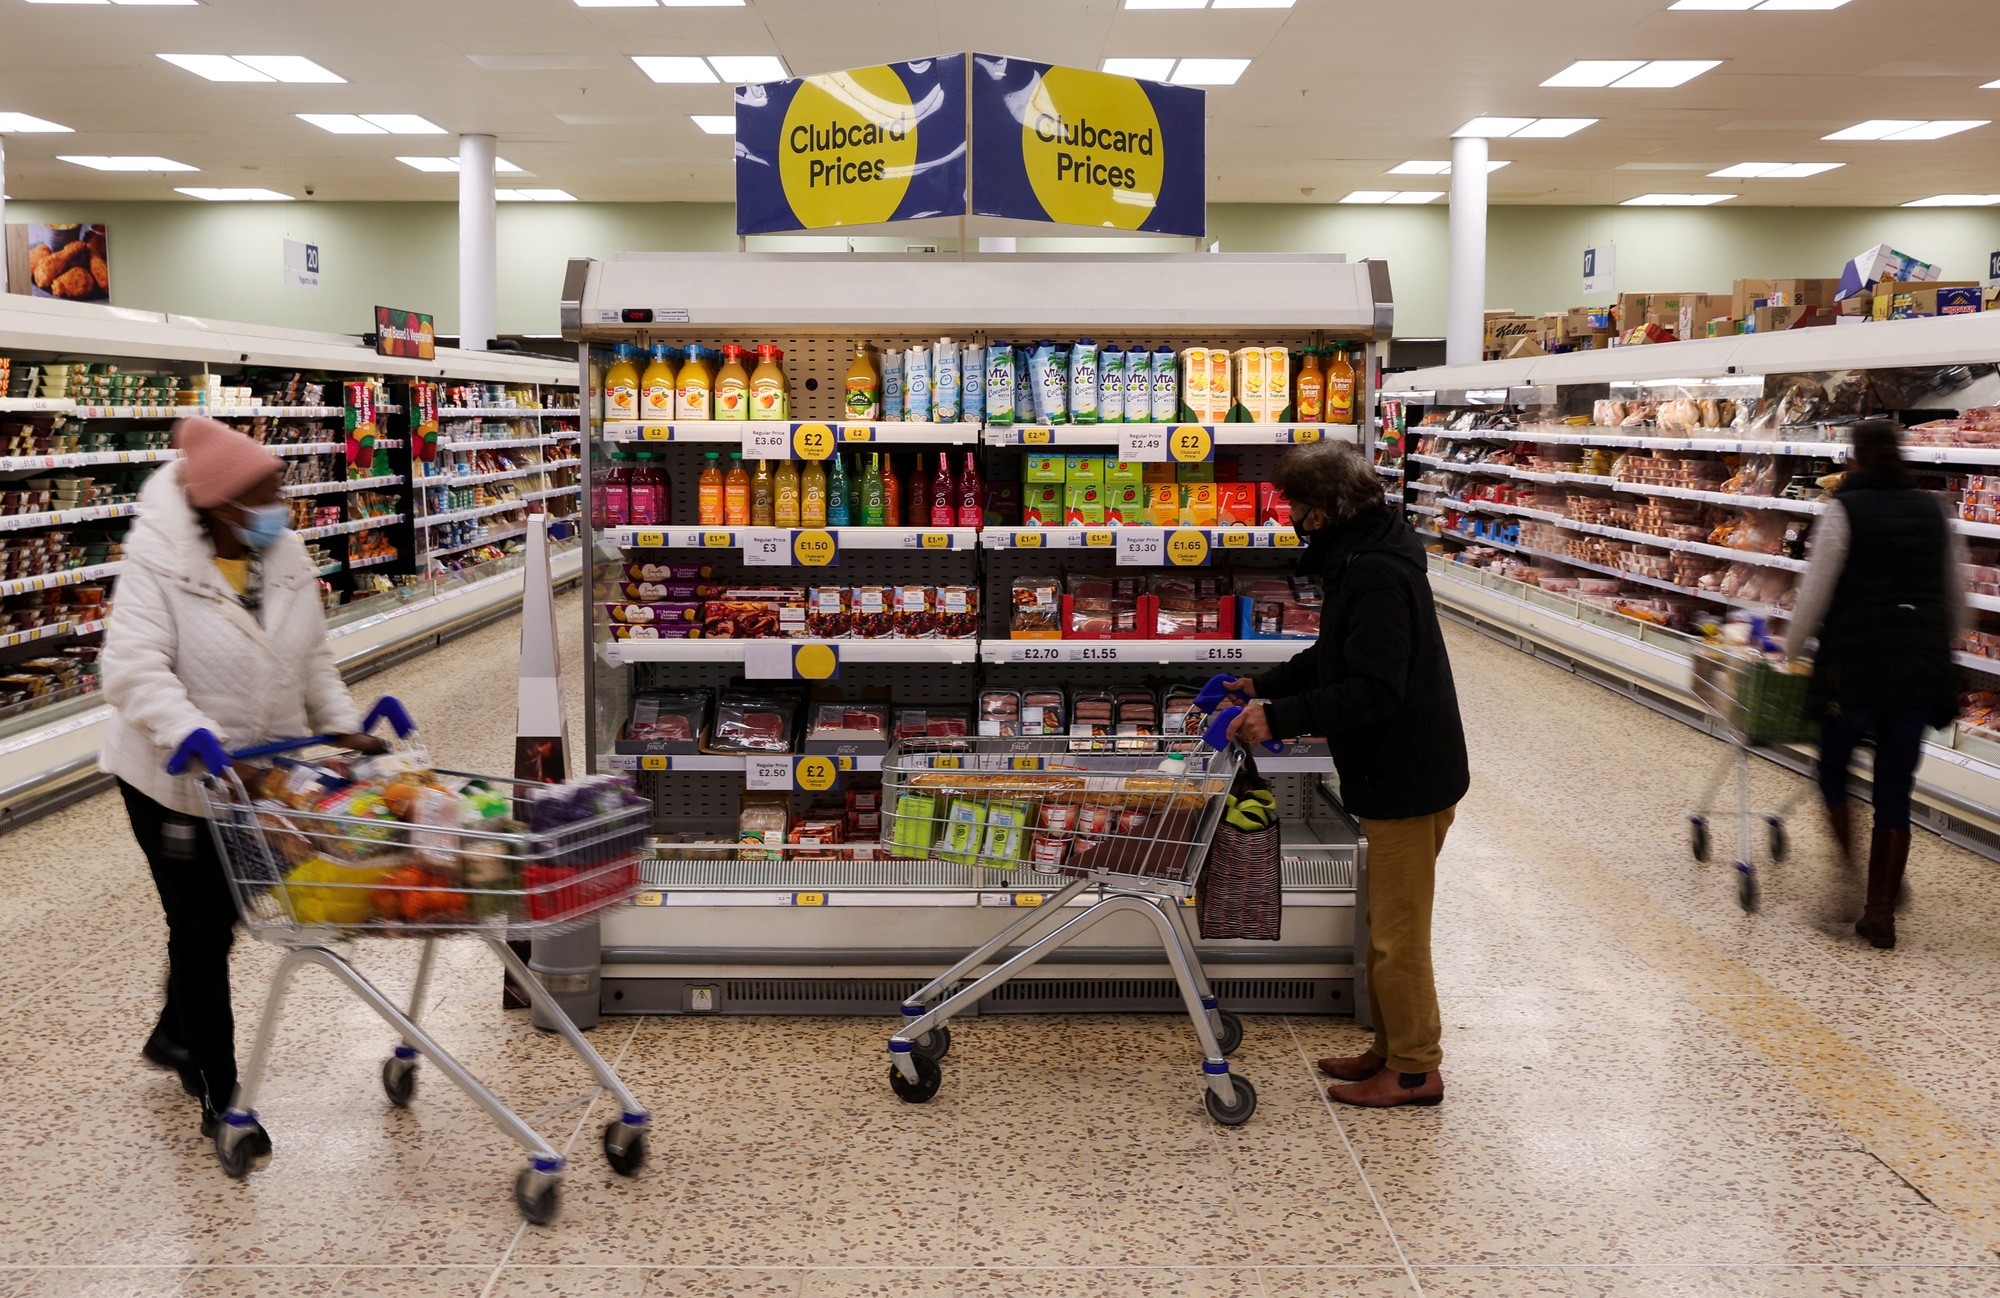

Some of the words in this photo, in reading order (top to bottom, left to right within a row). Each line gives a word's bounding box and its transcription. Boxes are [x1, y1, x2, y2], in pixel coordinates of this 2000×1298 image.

[790, 111, 906, 153] Clubcard
[1035, 112, 1153, 156] Clubcard
[809, 157, 886, 188] Prices
[1057, 152, 1136, 189] Prices
[308, 249, 318, 269] 20
[380, 324, 392, 337] Plant
[393, 326, 406, 339] Based
[410, 328, 432, 344] Vegetarian
[989, 367, 1009, 378] VITA
[1075, 366, 1095, 376] VITA
[1101, 373, 1121, 384] VITA
[1127, 373, 1148, 384] VITA
[1154, 373, 1174, 384] VITA
[1334, 382, 1349, 390] Lean
[362, 386, 371, 425] Vegetarian
[426, 387, 434, 424] Vegetarian
[755, 437, 783, 445] £3.60
[804, 433, 823, 446] £2
[1131, 440, 1160, 448] £2.49
[1181, 435, 1199, 449] £2
[763, 544, 777, 553] £3
[800, 542, 828, 550] £1.50
[1129, 544, 1157, 552] £3.30
[1173, 541, 1201, 550] £1.65
[1024, 649, 1059, 659] £2.70
[1082, 649, 1117, 659] £1.55
[1208, 649, 1243, 659] £1.55
[758, 769, 786, 777] £2.50
[806, 765, 824, 777] £2
